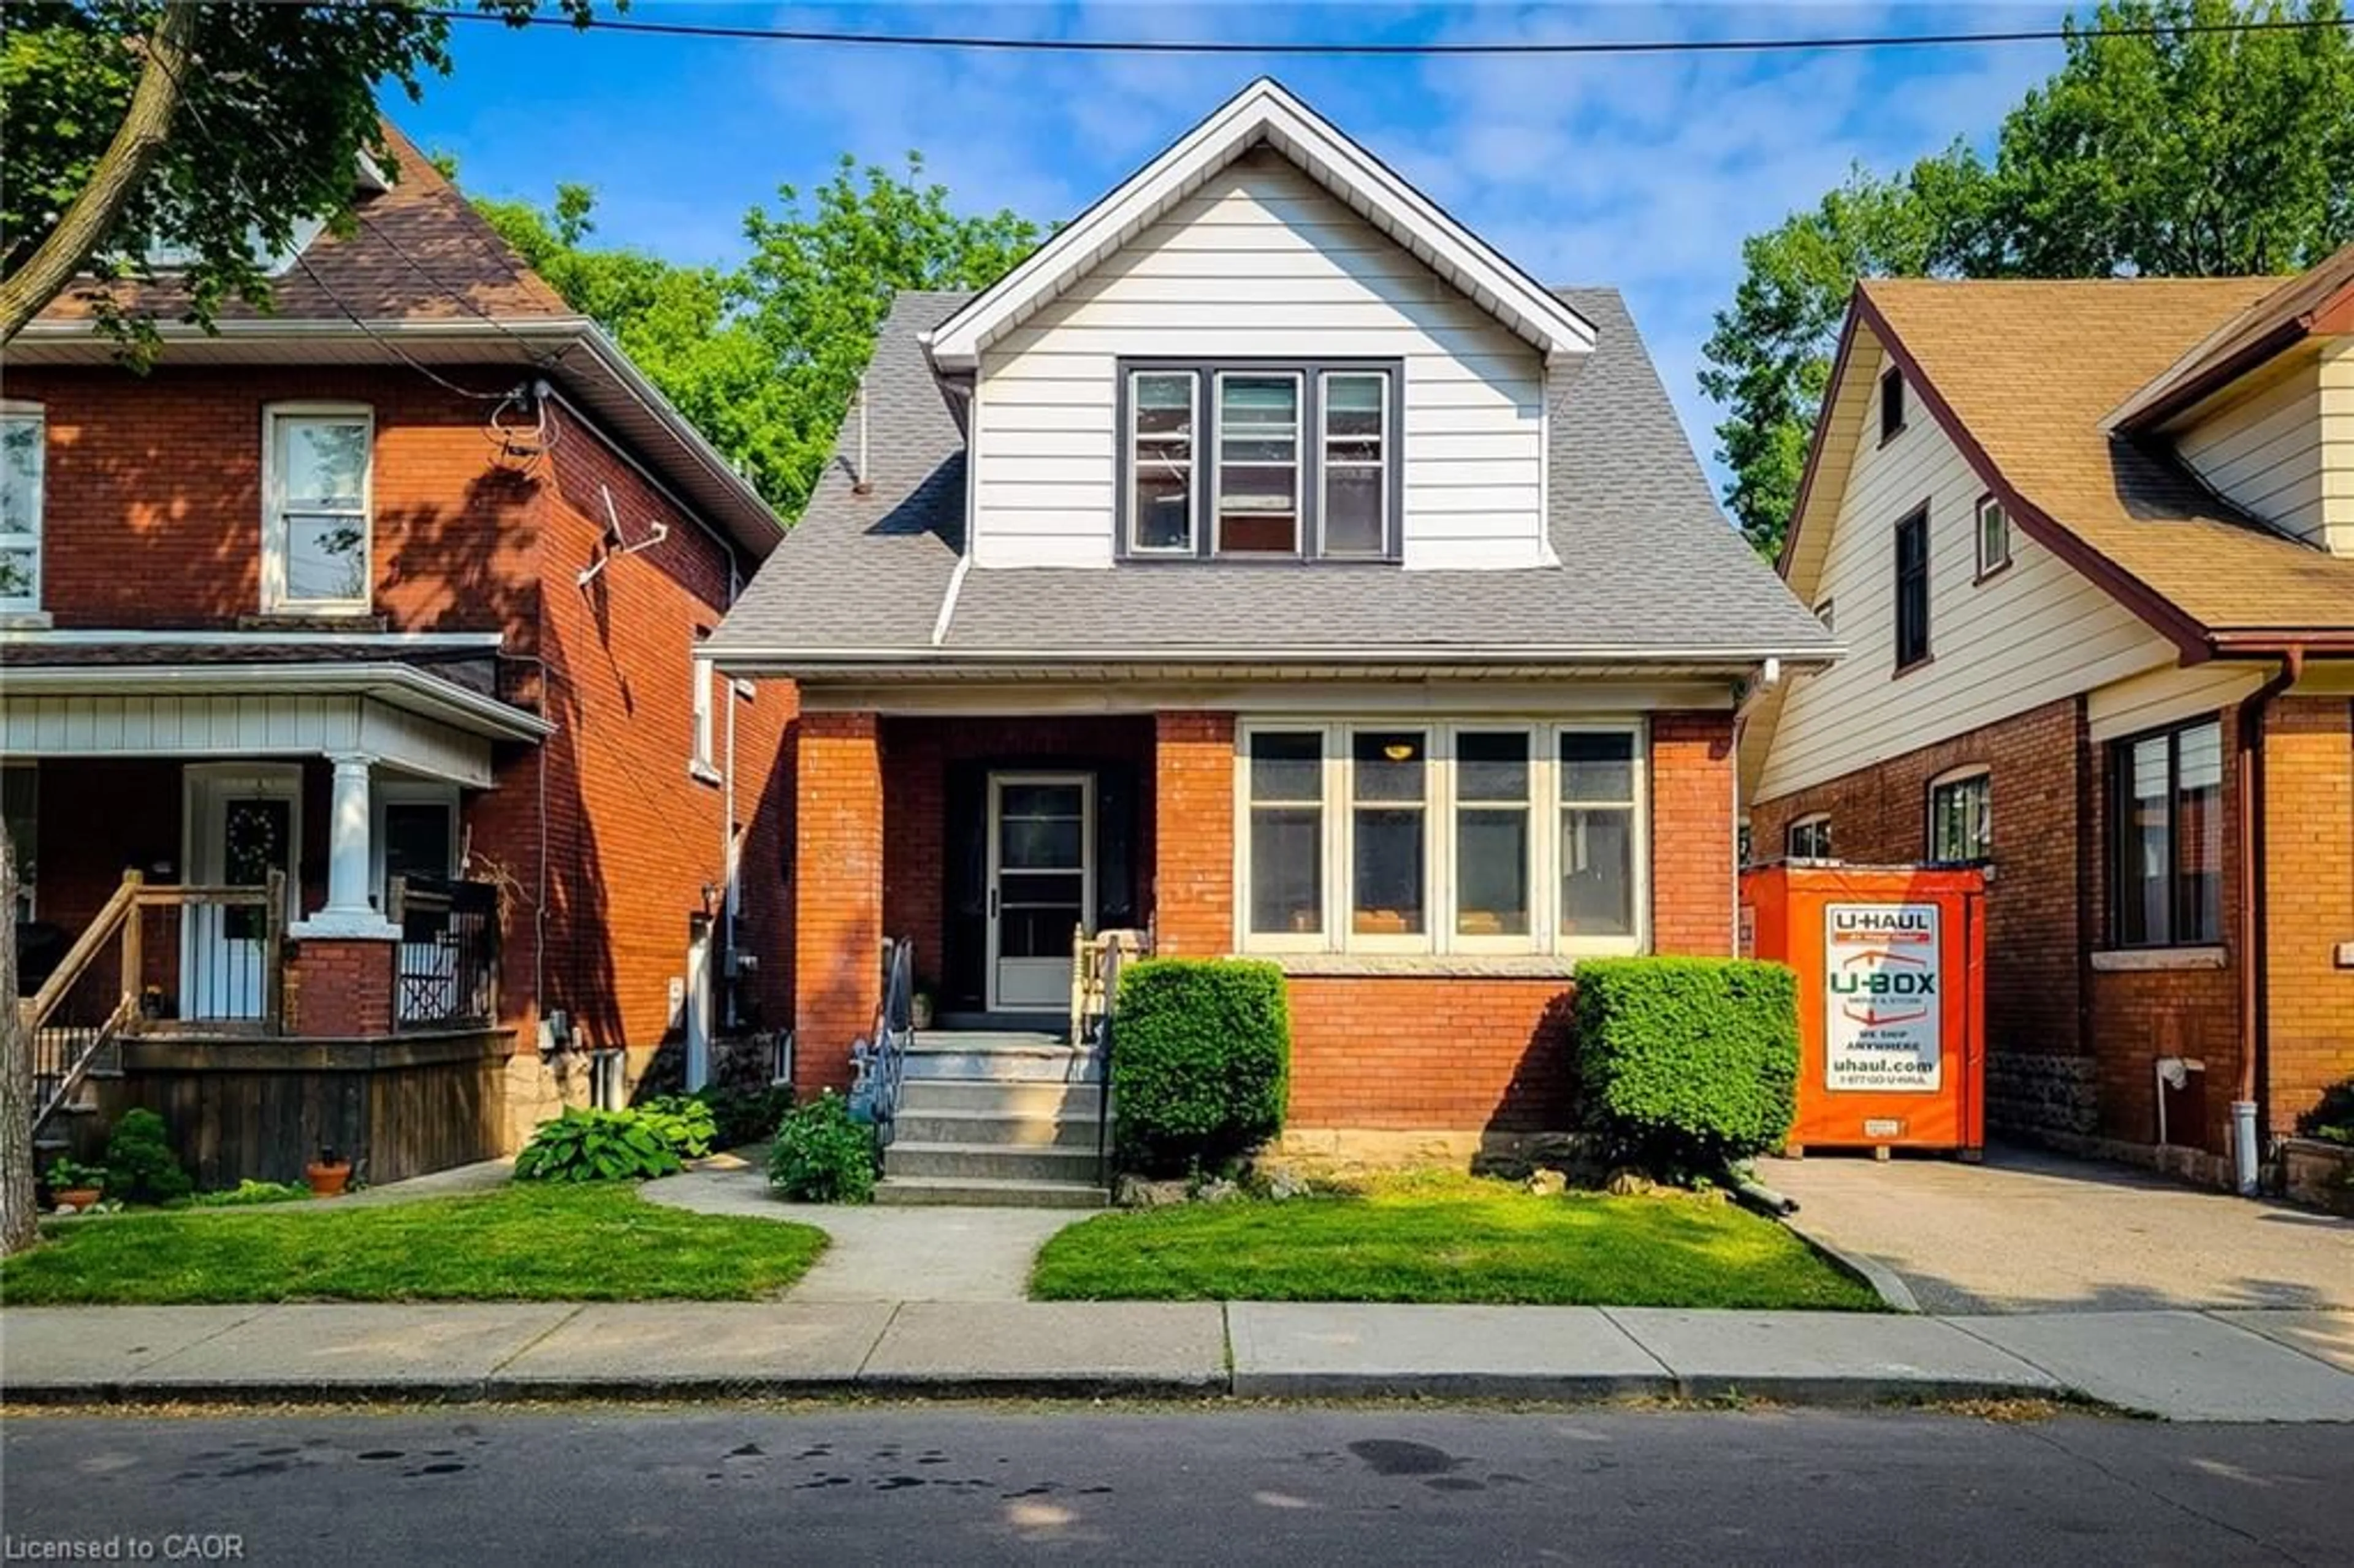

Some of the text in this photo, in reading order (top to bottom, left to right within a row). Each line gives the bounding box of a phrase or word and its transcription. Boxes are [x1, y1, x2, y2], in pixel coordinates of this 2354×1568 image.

[1837, 914, 1929, 929] U-HAUL
[1830, 972, 1935, 994] U-BOX
[1846, 1042, 1920, 1051] ANYWHERE
[1834, 1059, 1933, 1073] uhaul.com
